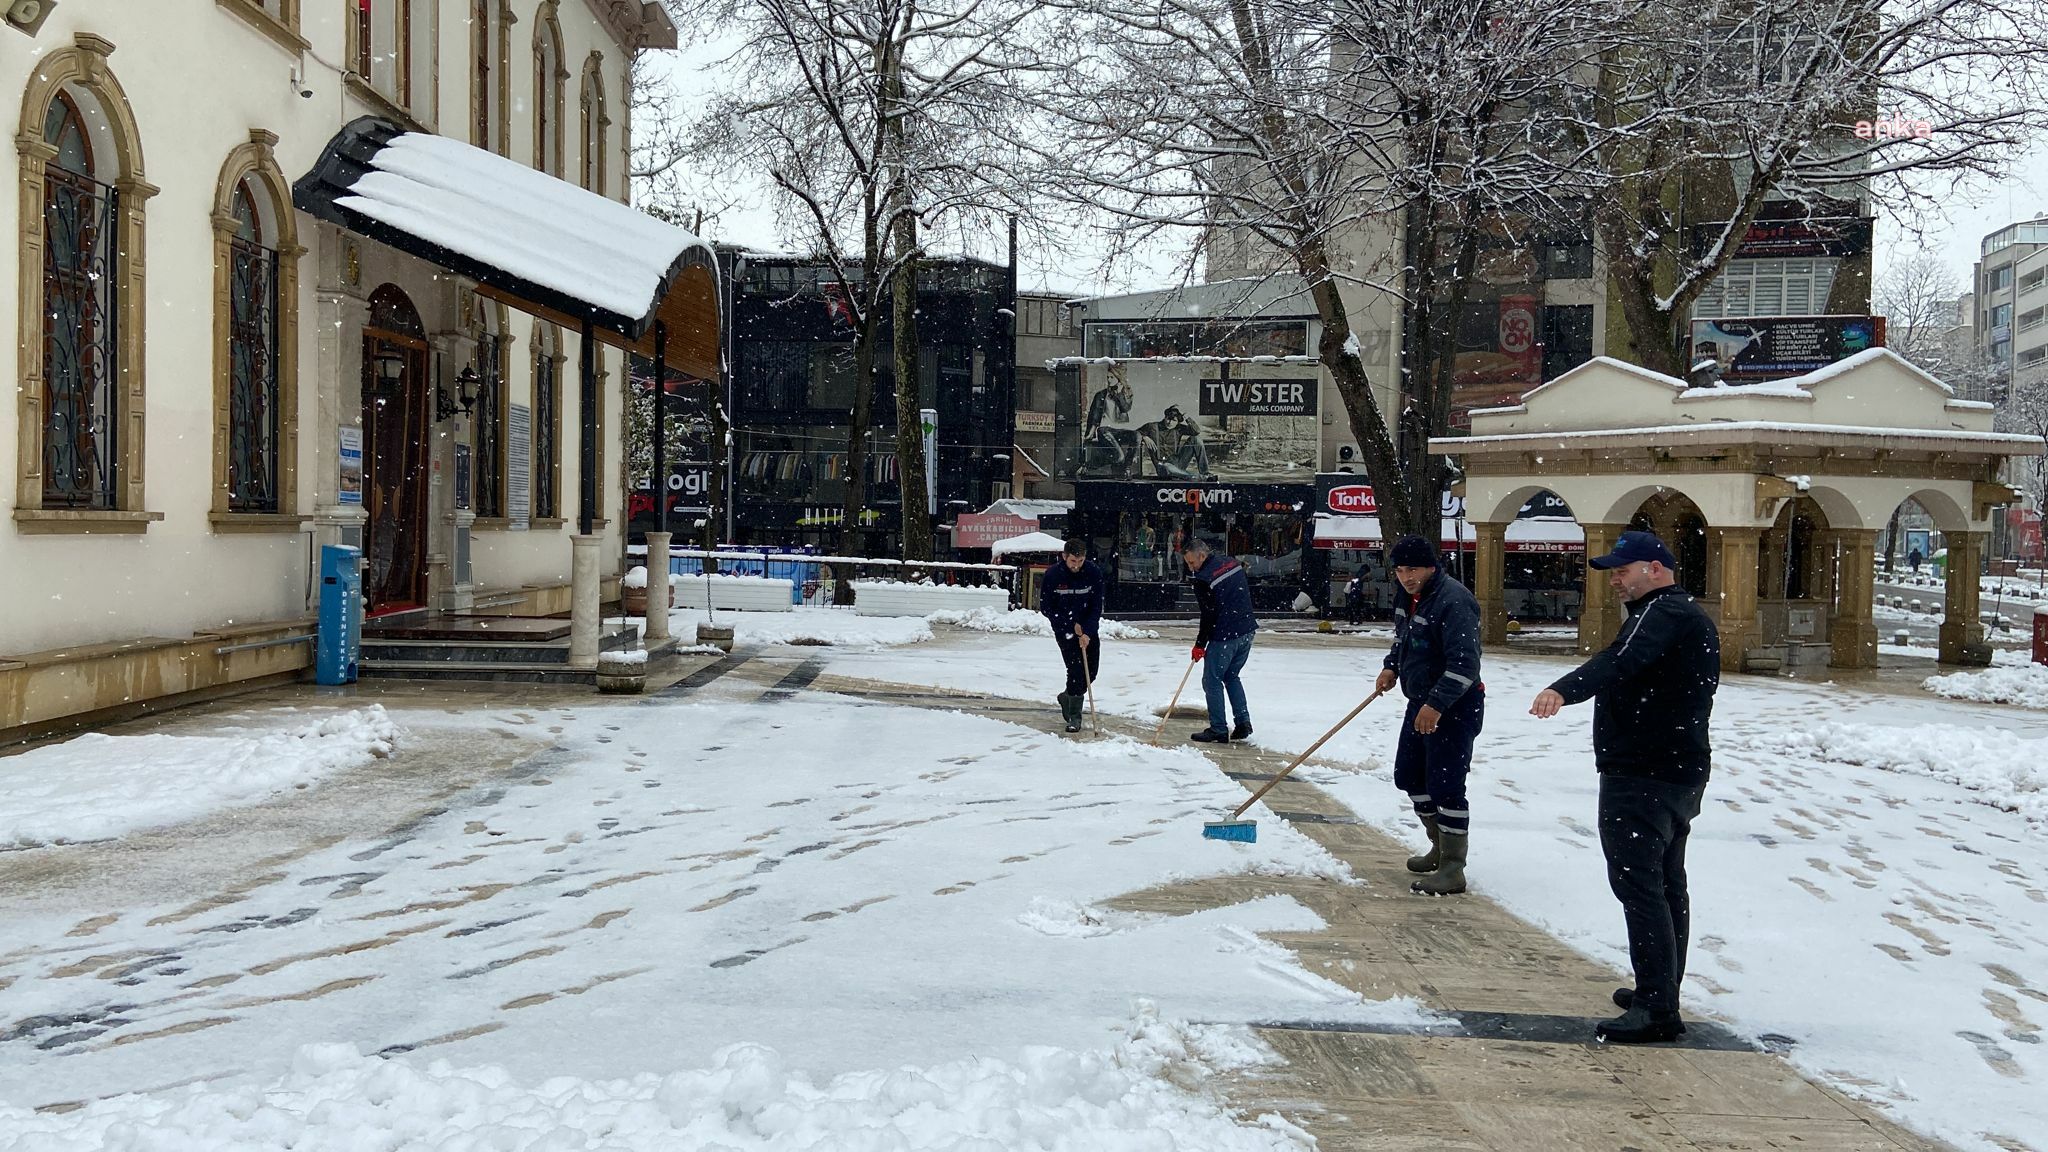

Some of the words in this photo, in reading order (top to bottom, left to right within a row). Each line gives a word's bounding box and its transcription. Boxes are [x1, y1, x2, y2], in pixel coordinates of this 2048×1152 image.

[1501, 319, 1530, 333] NO
[1504, 333, 1532, 347] ON
[1249, 405, 1269, 413] JEANS
[1270, 405, 1305, 413] COMPANY
[1517, 543, 1564, 552] ziyafet
[339, 591, 348, 678] DEZENFEKTAN
